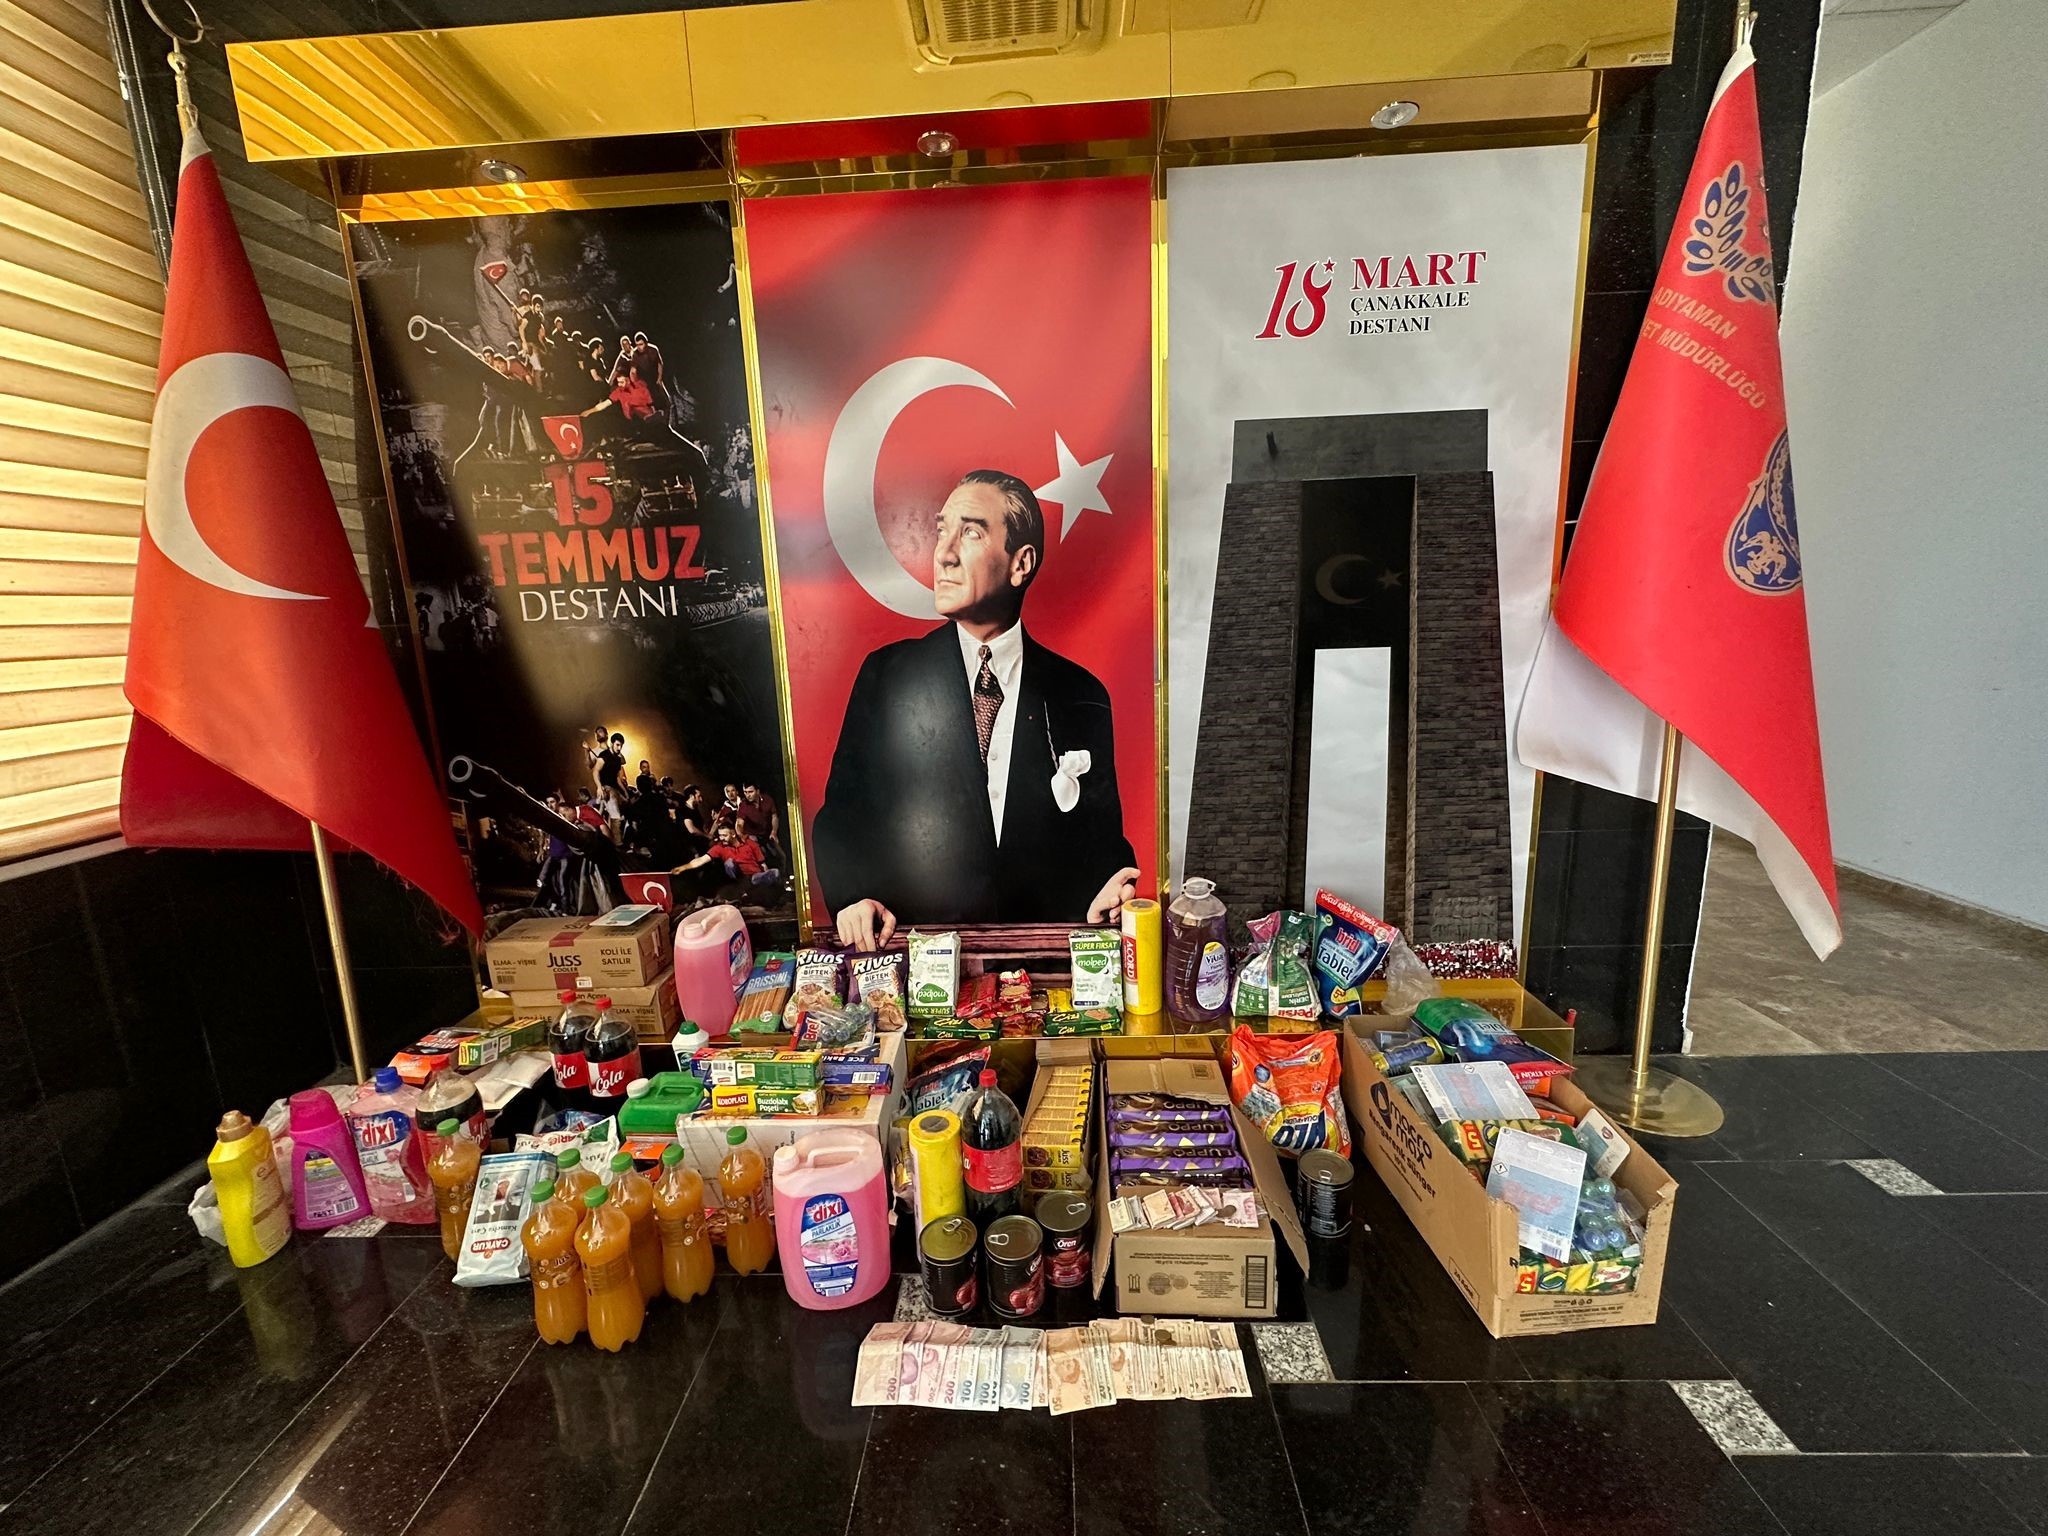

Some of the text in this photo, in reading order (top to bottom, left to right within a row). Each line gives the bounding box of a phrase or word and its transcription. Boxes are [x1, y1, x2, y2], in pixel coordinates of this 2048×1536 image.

[1351, 250, 1487, 291] MART
[1255, 260, 1329, 339] 18
[1350, 291, 1470, 316] ÇANAKKALE
[1651, 286, 1739, 340] ADIYAMAN
[1349, 316, 1431, 335] DESTANI
[1656, 326, 1767, 409] MÜDÜRLÜĞÜ
[544, 461, 614, 527] 15
[478, 525, 706, 587] TEMMUZ
[519, 586, 678, 623] DESTANI
[600, 947, 632, 956] KOLİ İLE
[1095, 941, 1118, 949] FIRSAT
[547, 952, 582, 968] Juss
[601, 957, 631, 966] SATILIR
[1078, 956, 1107, 968] molped
[1126, 940, 1135, 978] ACORD
[1318, 945, 1354, 981] Tablet
[917, 989, 947, 999] molped
[596, 1070, 625, 1093] Cola
[361, 1117, 396, 1148] dixi
[1168, 1122, 1225, 1132] LUPPO
[813, 1200, 842, 1223] dixi
[886, 1377, 898, 1401] 200
[943, 1380, 955, 1405] 200
[960, 1379, 973, 1404] 100
[979, 1382, 991, 1406] 100
[1019, 1382, 1031, 1405] 100
